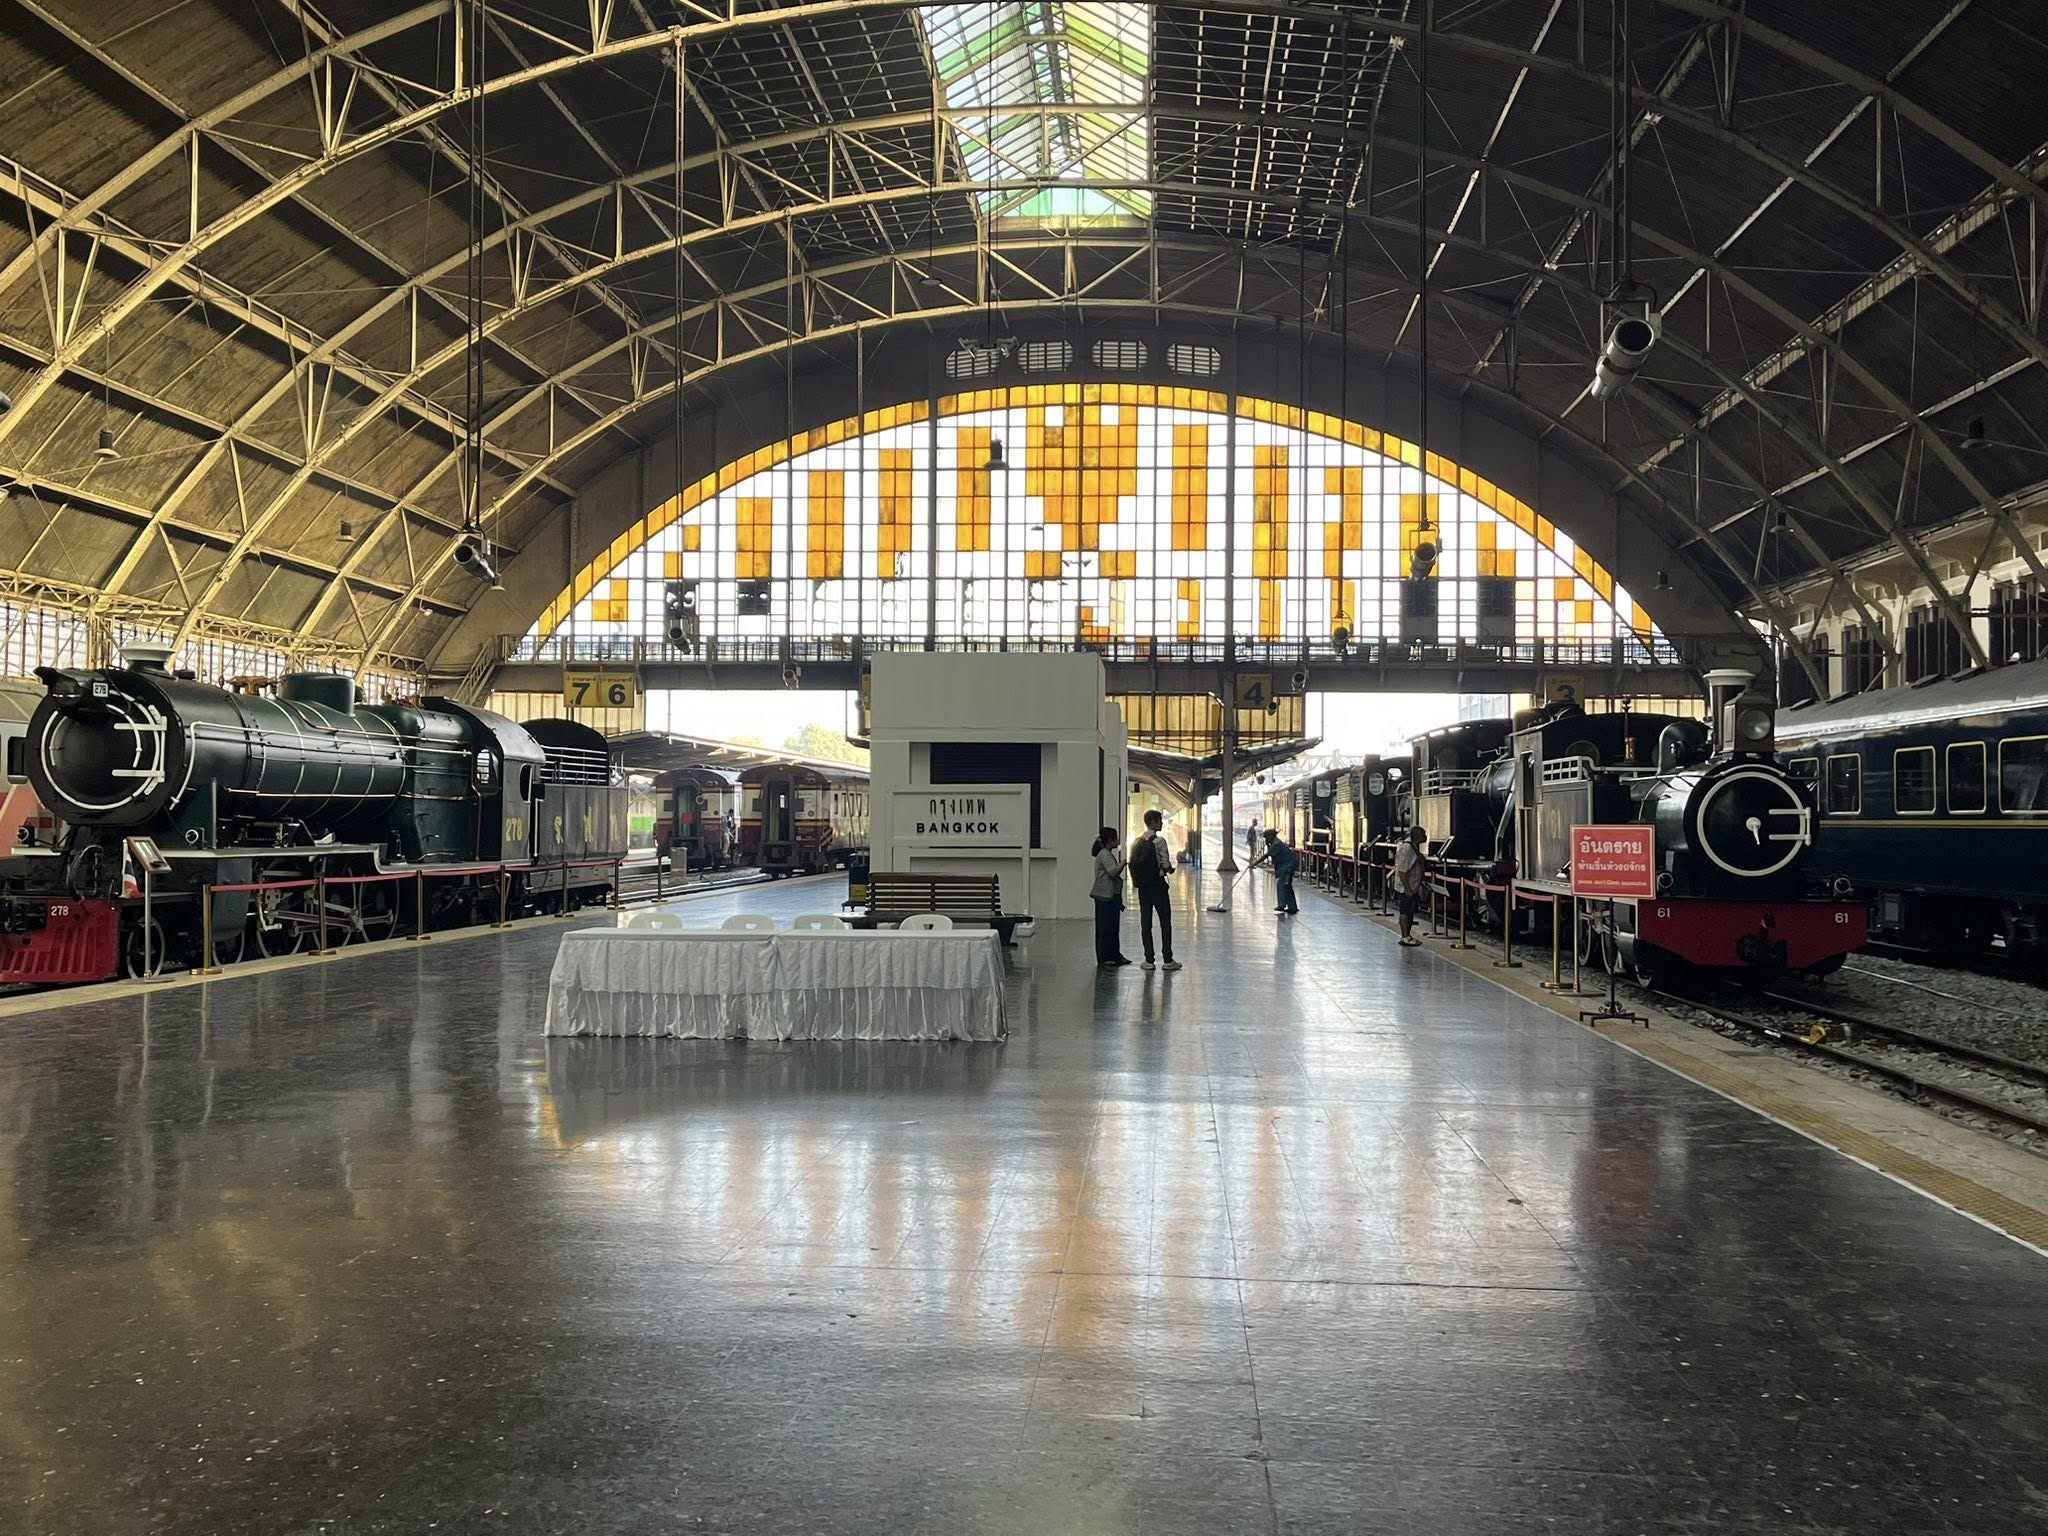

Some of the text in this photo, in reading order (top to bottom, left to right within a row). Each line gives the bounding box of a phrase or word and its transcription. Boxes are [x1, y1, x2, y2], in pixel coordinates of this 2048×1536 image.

[572, 682, 591, 705] 7
[608, 683, 626, 705] 6
[1243, 682, 1265, 706] 4
[930, 799, 986, 821] กรุงเทพ
[505, 817, 522, 841] 278
[916, 822, 999, 834] BANGKOK
[1550, 808, 1561, 839] 61
[1579, 835, 1642, 854] อันตราย
[51, 905, 69, 916] 278
[1657, 907, 1671, 918] 61
[1834, 912, 1849, 923] 61
